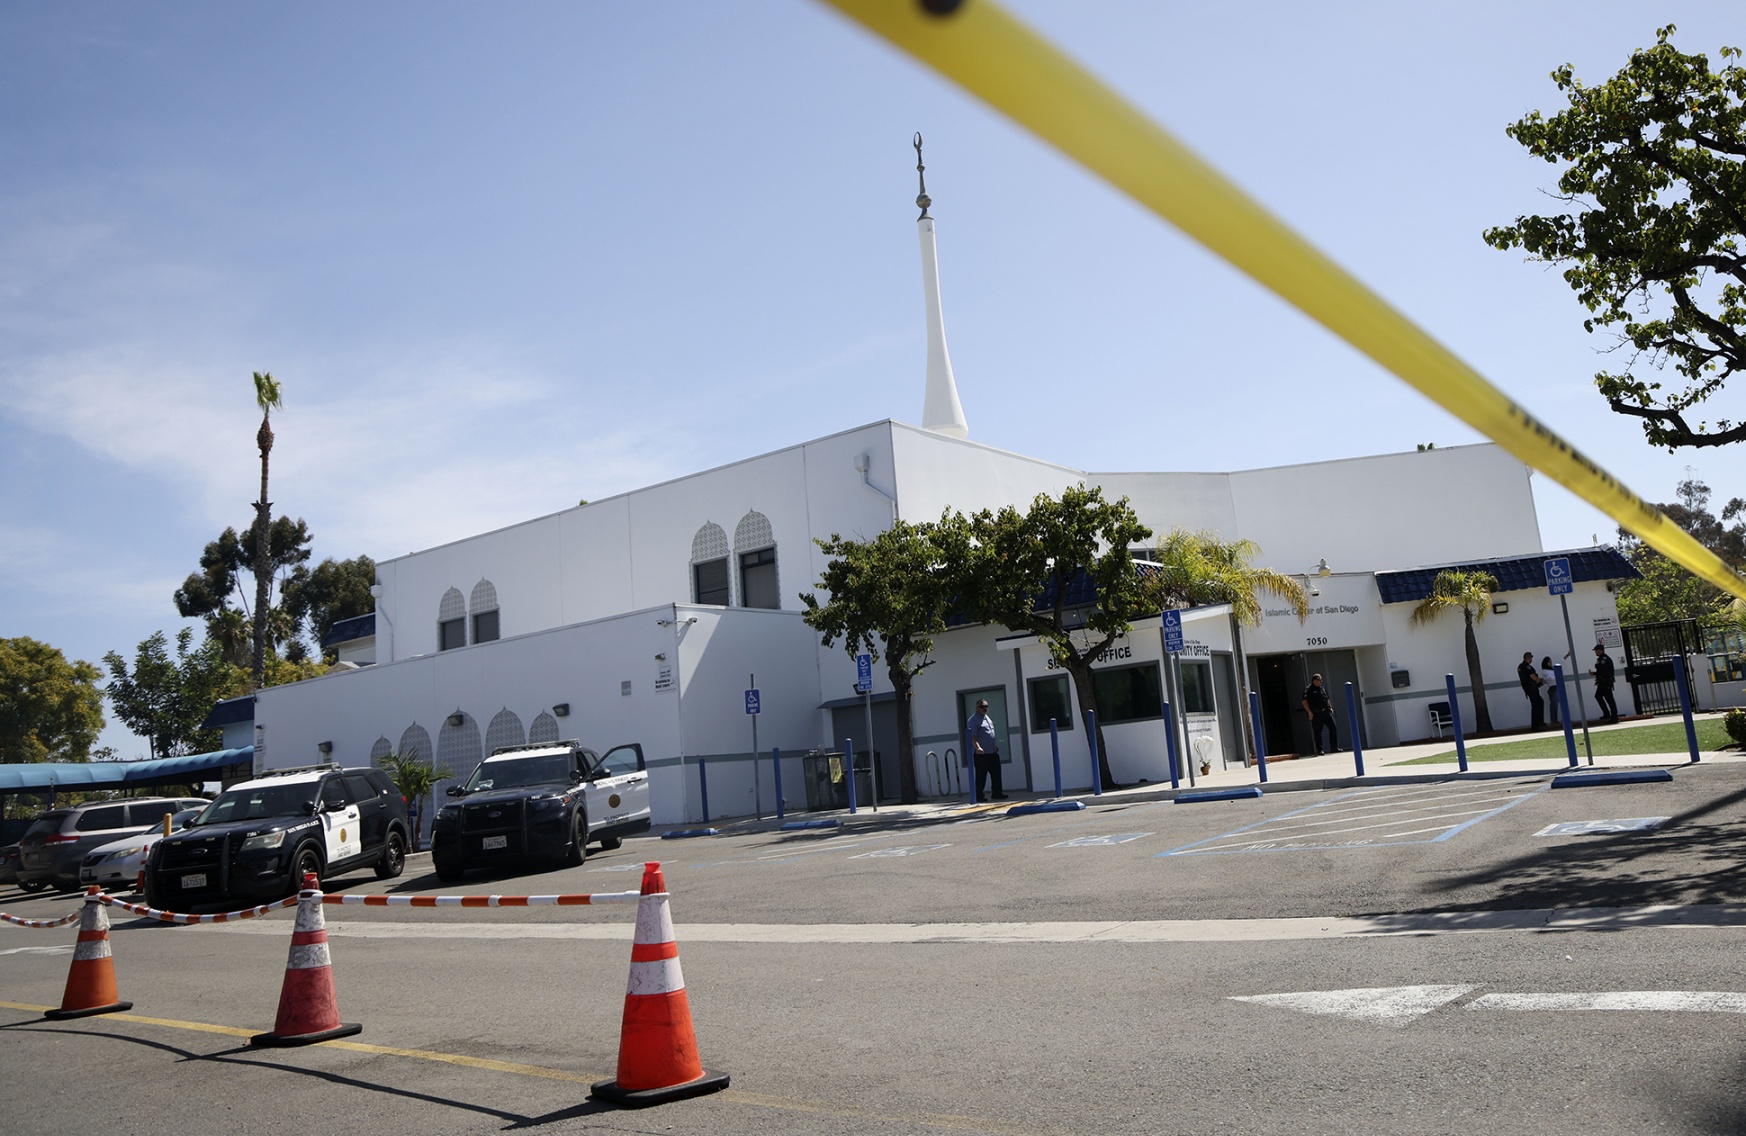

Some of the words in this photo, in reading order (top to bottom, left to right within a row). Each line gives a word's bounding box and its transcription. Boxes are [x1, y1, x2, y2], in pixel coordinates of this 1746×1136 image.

[1548, 576, 1571, 585] PARKING
[1553, 585, 1568, 593] ONLY
[1265, 608, 1291, 617] Islamic
[1315, 606, 1323, 614] of
[1324, 605, 1339, 614] San
[1339, 605, 1359, 615] Diego
[1168, 632, 1179, 640] ONLY
[1306, 637, 1328, 646] 7050
[1097, 646, 1132, 662] OFFICE
[1194, 645, 1210, 657] OFFICE
